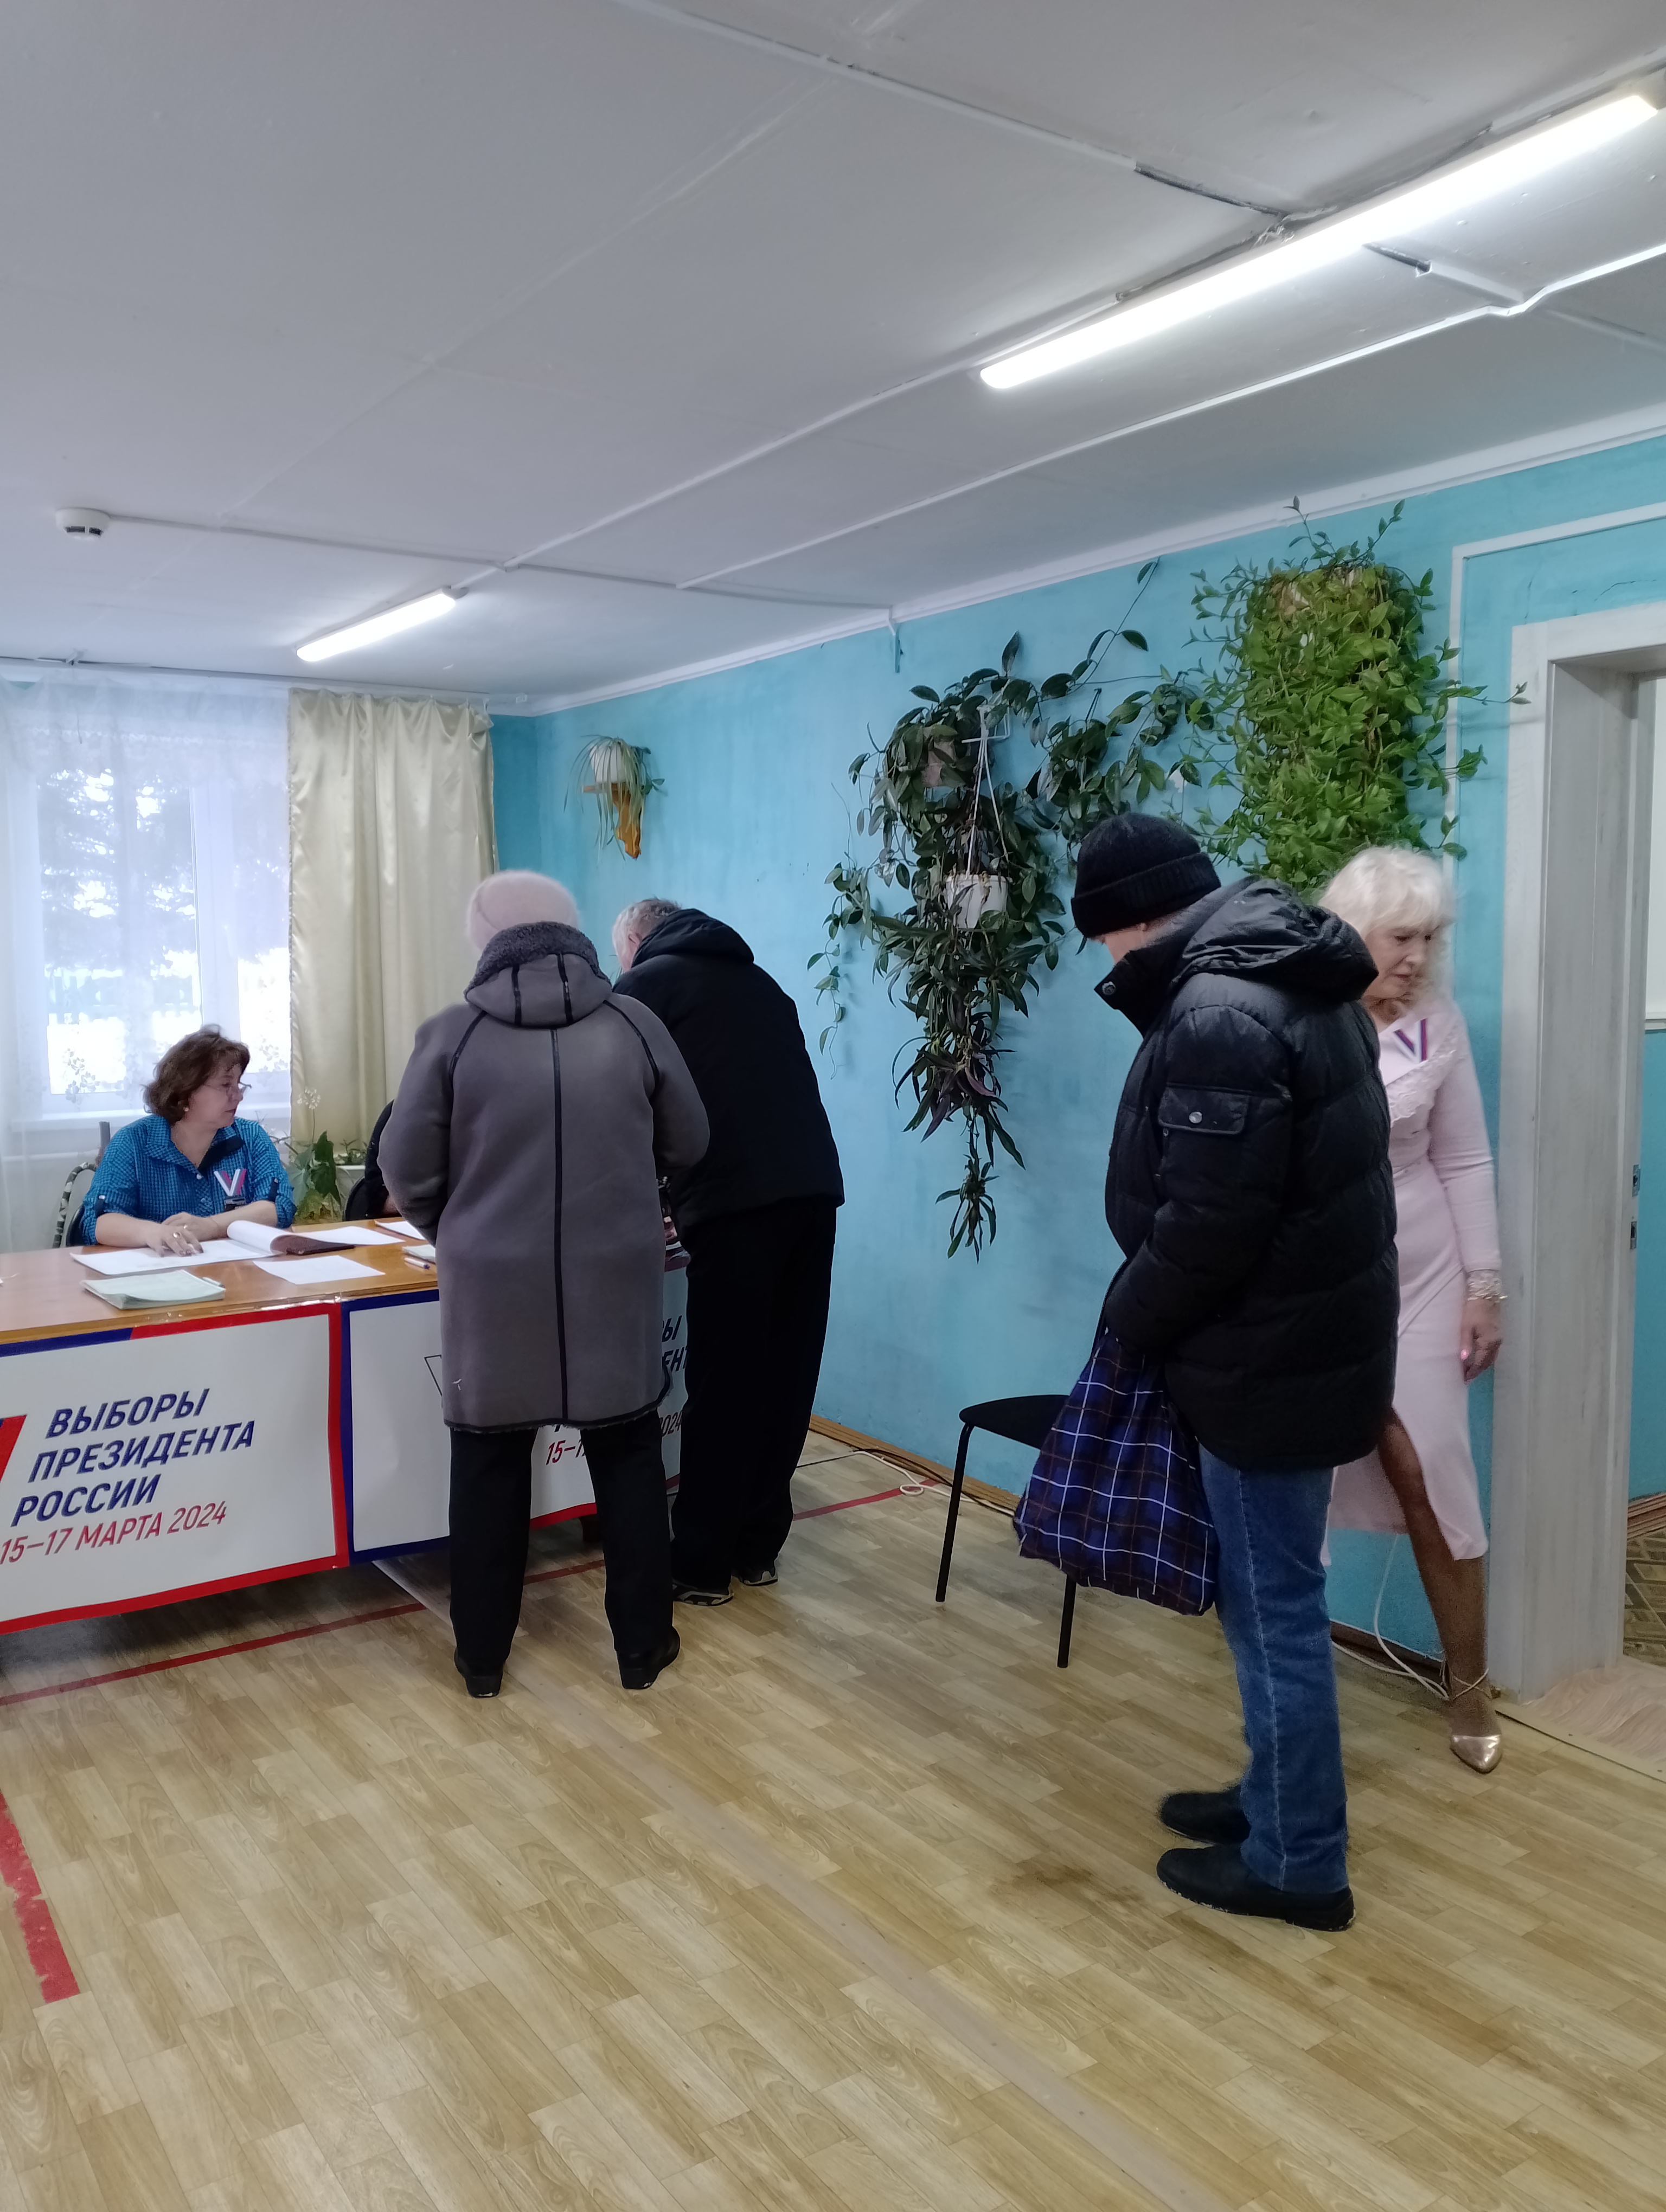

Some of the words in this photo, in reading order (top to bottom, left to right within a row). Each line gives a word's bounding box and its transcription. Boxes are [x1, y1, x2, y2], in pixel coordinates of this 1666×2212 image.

[46, 1388, 210, 1439] ВЫБОРЫ
[28, 1420, 255, 1483] ПРЕЗИДЕНТА
[11, 1474, 162, 1527] РОССИИ
[0, 1527, 73, 1565] 15–17
[75, 1512, 162, 1551] МАРТА
[167, 1501, 227, 1534] 2024
